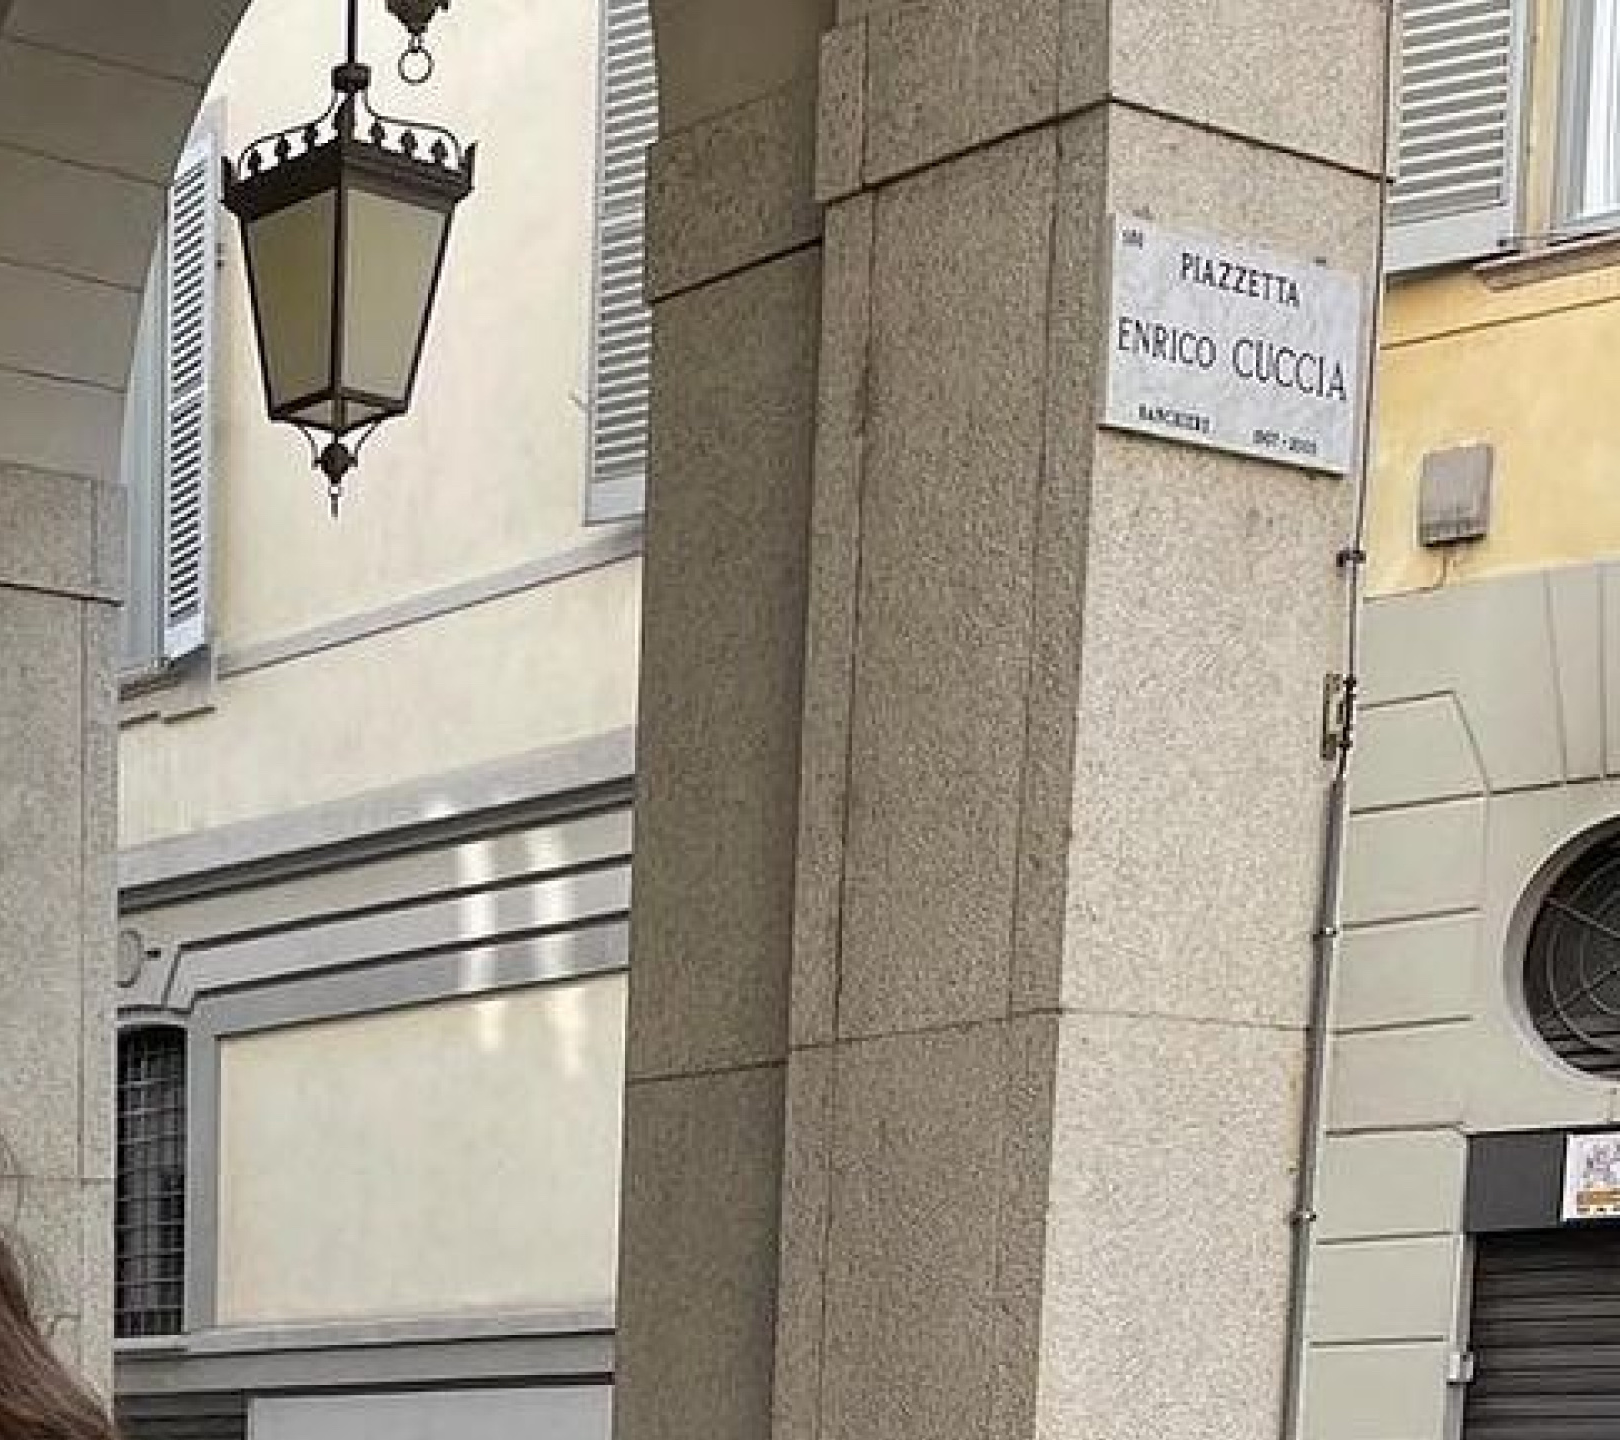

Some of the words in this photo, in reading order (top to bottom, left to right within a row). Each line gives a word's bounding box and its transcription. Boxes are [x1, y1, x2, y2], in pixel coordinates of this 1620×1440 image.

[1181, 253, 1300, 307] PIAZZETTA
[1118, 316, 1217, 370] ENRICO
[1232, 338, 1348, 401] CUCCIA
